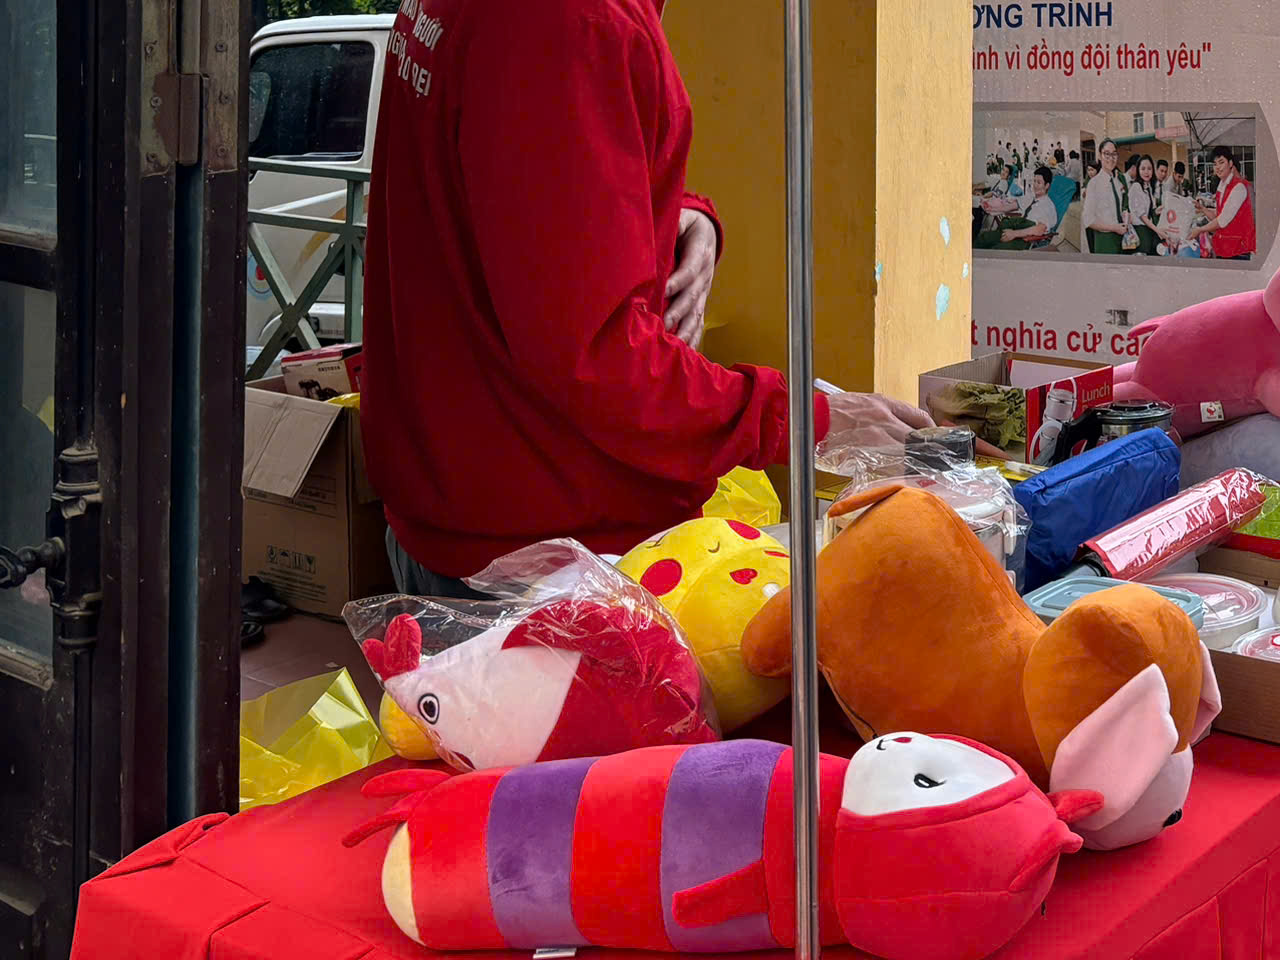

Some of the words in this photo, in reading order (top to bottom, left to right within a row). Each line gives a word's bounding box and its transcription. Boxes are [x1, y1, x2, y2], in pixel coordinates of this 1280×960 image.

[1005, 44, 1021, 71] vì
[1027, 38, 1074, 76] đồng
[1081, 43, 1110, 76] đội
[1116, 43, 1160, 70] thân
[987, 321, 1057, 352] nghĩa
[1066, 324, 1103, 353] cử
[1082, 381, 1110, 402] Lunch
